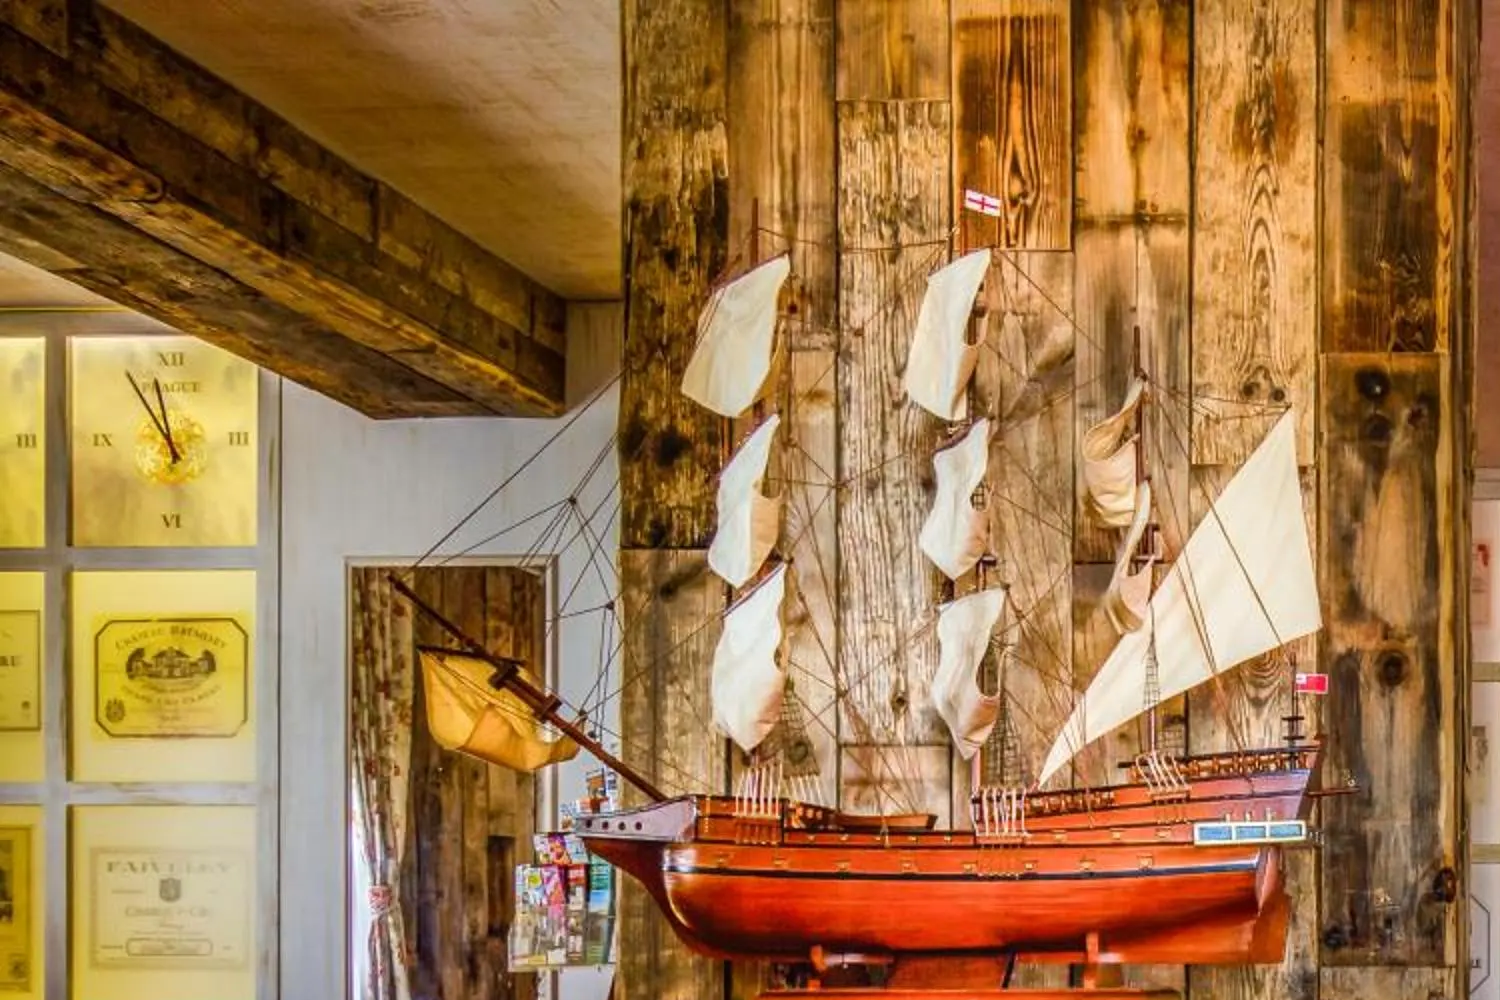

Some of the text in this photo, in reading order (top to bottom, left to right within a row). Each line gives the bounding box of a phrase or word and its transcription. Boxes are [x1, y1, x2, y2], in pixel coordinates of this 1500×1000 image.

[158, 352, 184, 366] XII
[16, 434, 37, 448] III
[93, 434, 113, 447] IX
[228, 431, 249, 446] III
[161, 514, 182, 528] VI
